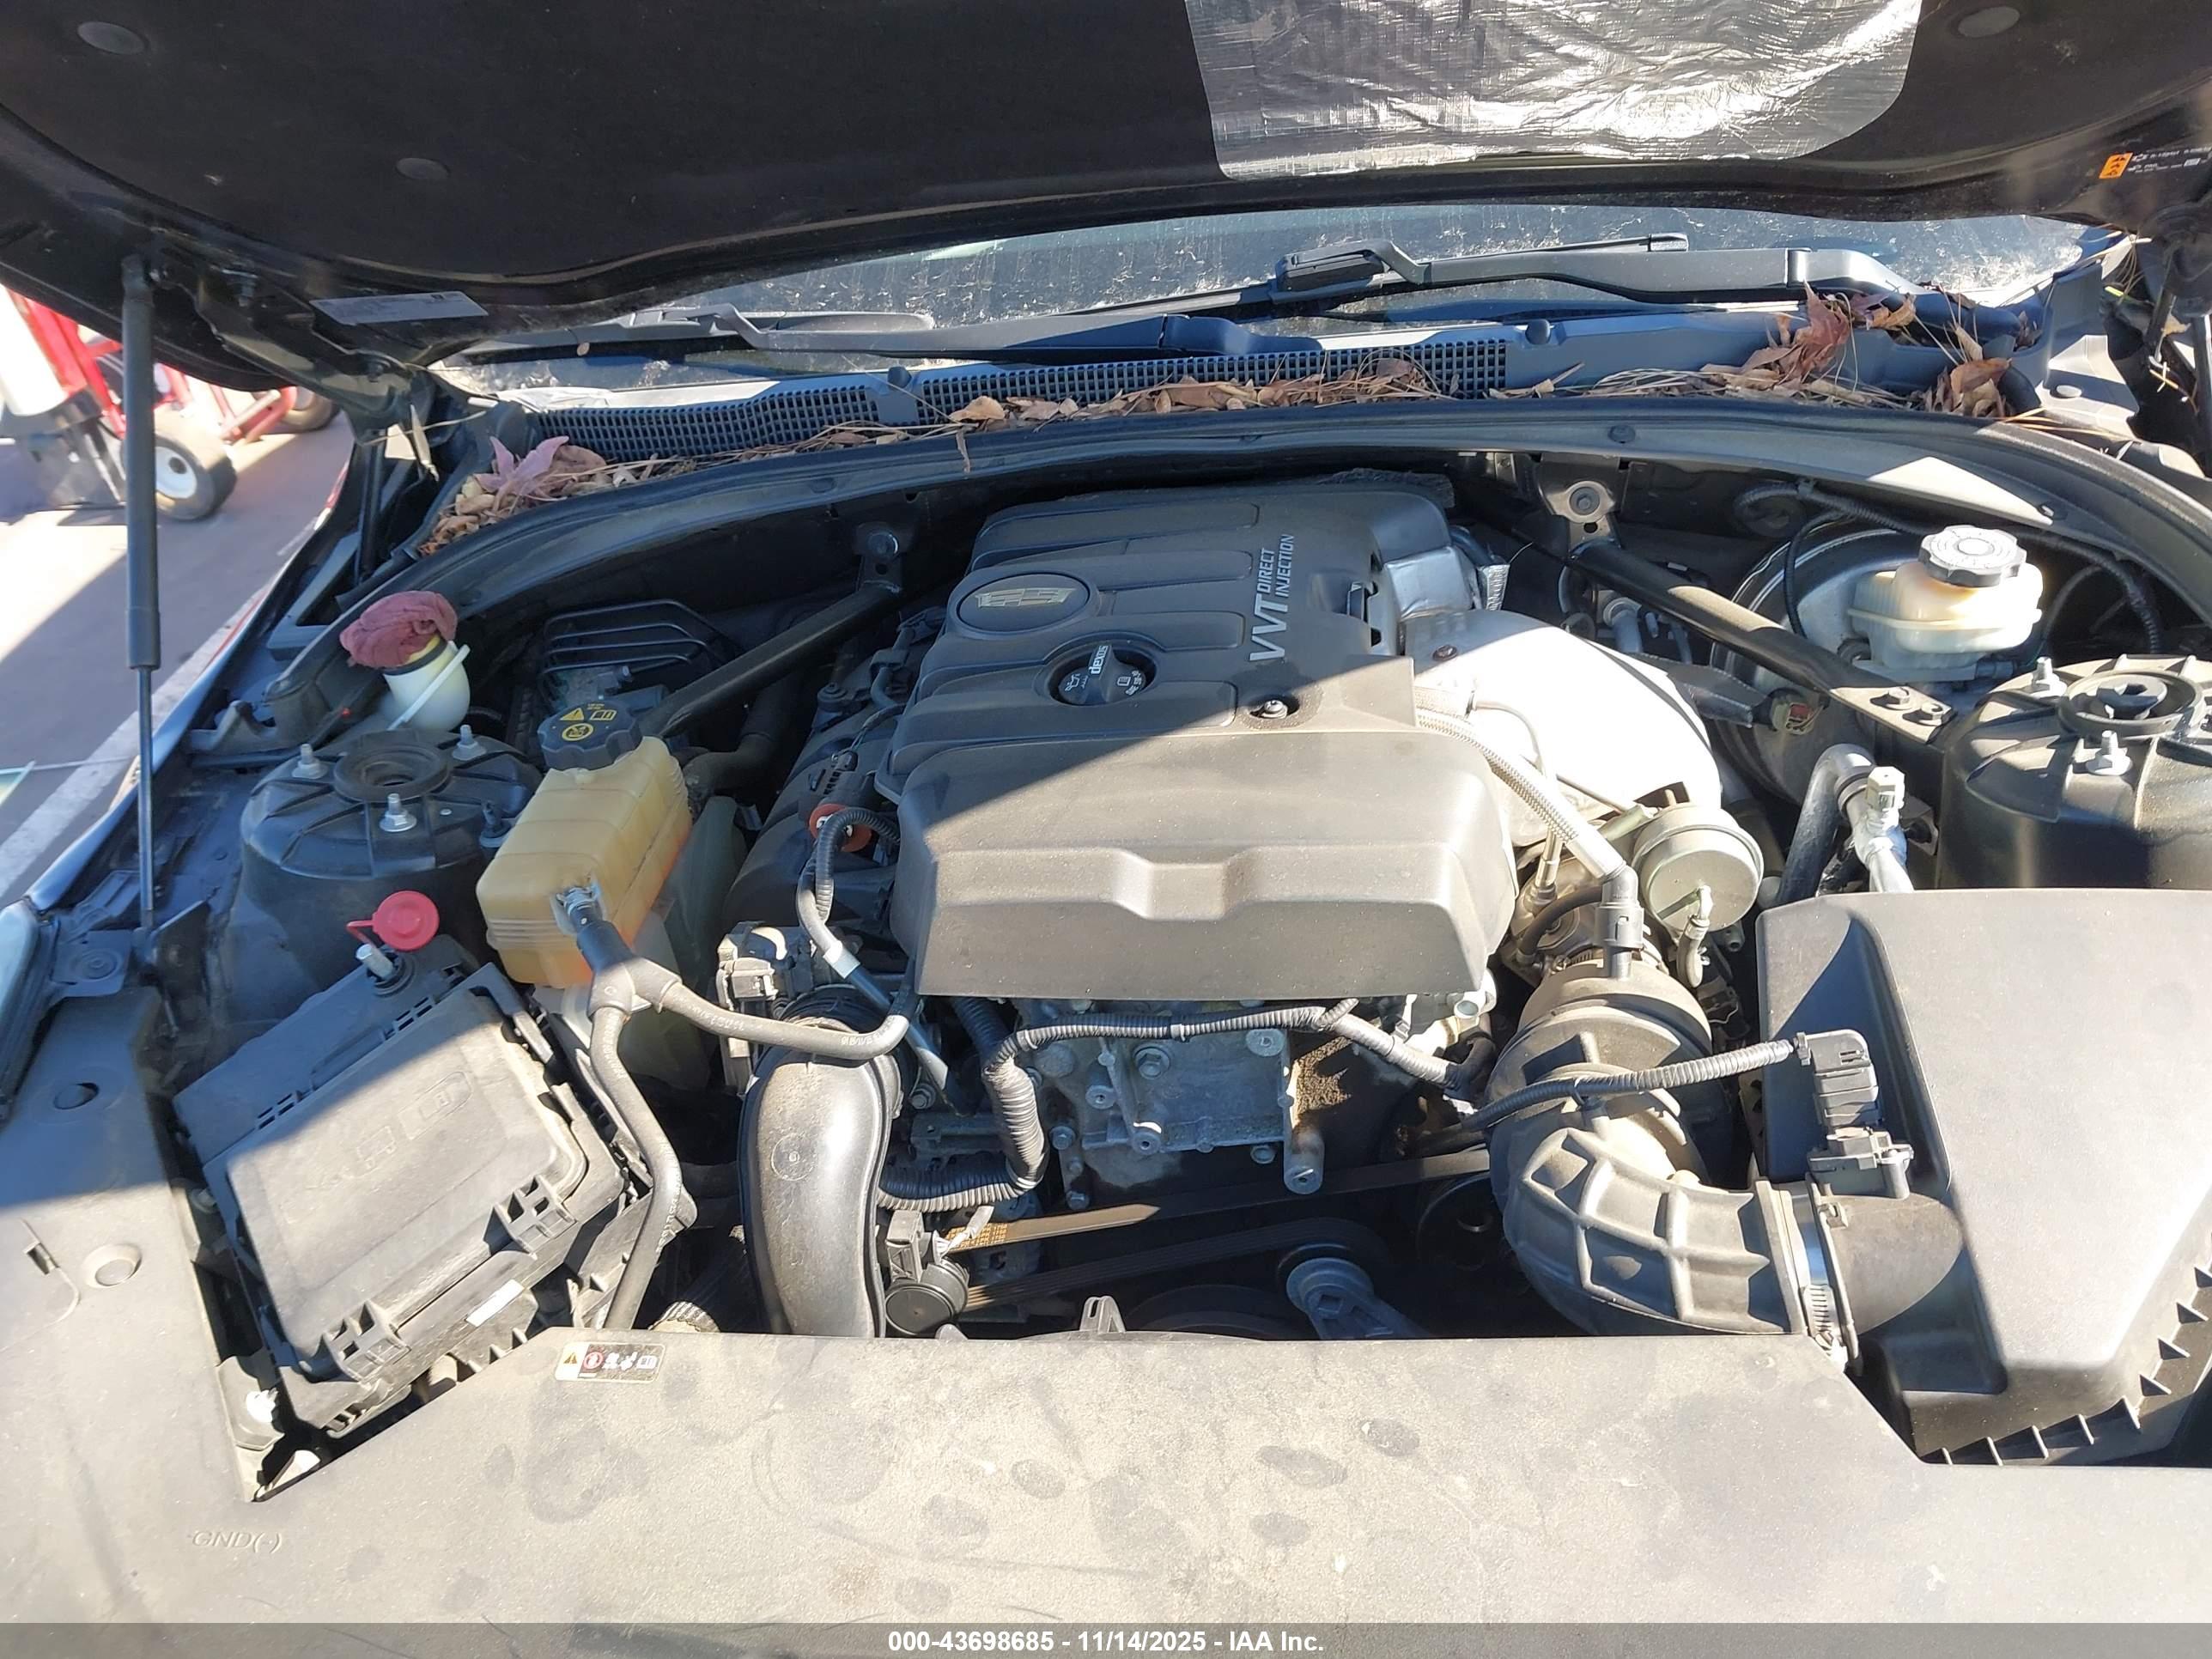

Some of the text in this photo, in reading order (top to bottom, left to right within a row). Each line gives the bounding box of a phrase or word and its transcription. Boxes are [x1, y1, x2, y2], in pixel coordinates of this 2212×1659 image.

[1257, 548, 1274, 593] DIRECT
[1275, 534, 1295, 598] INJECTION
[1249, 593, 1288, 661] VVT
